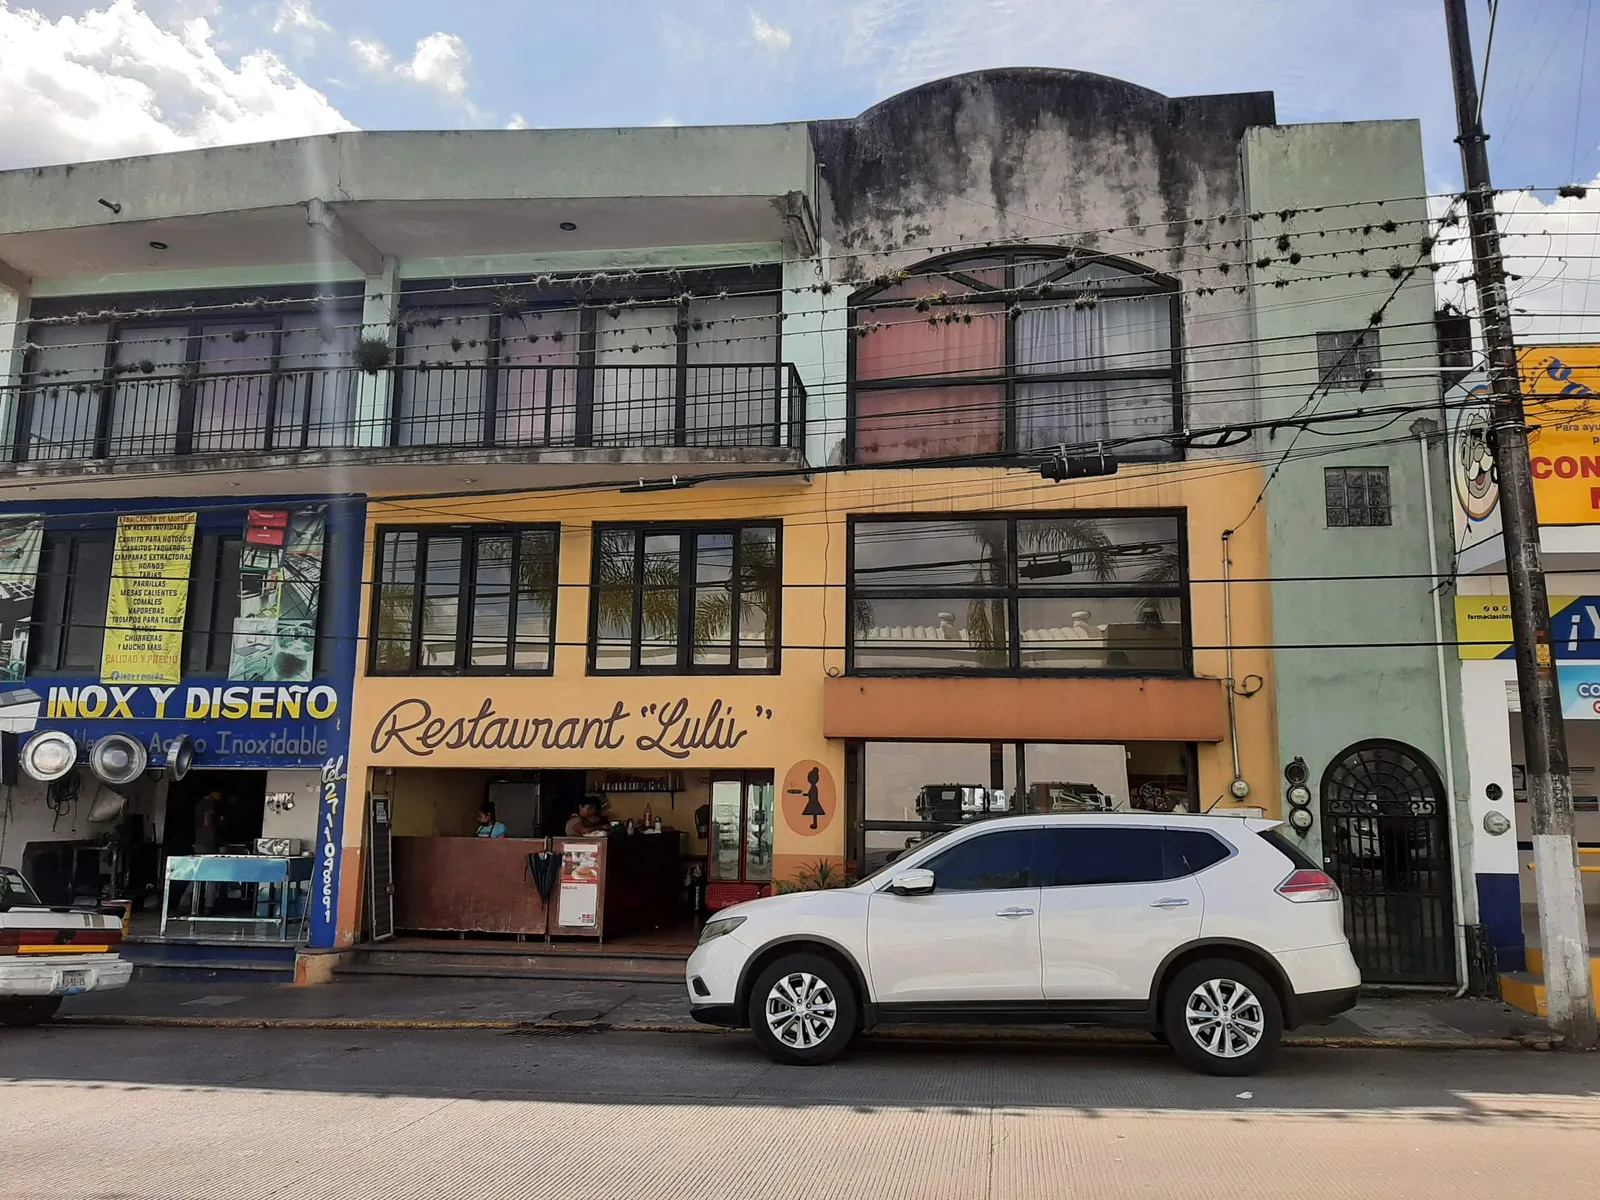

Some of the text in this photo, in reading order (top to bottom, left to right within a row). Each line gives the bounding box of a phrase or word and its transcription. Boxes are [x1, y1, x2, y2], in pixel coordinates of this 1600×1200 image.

[1555, 424, 1579, 432] Para
[1531, 456, 1600, 480] CON
[133, 598, 162, 606] COMALES
[128, 607, 165, 615] VAPORERAS
[112, 616, 142, 624] TROMPOS
[142, 616, 159, 624] PARA
[105, 654, 138, 664] CALIDAD
[147, 655, 179, 664] PRECIO
[47, 685, 338, 720] INOX Y DISEÑO
[371, 697, 631, 757] Restaurant
[149, 725, 328, 755] Aco Inoxidable
